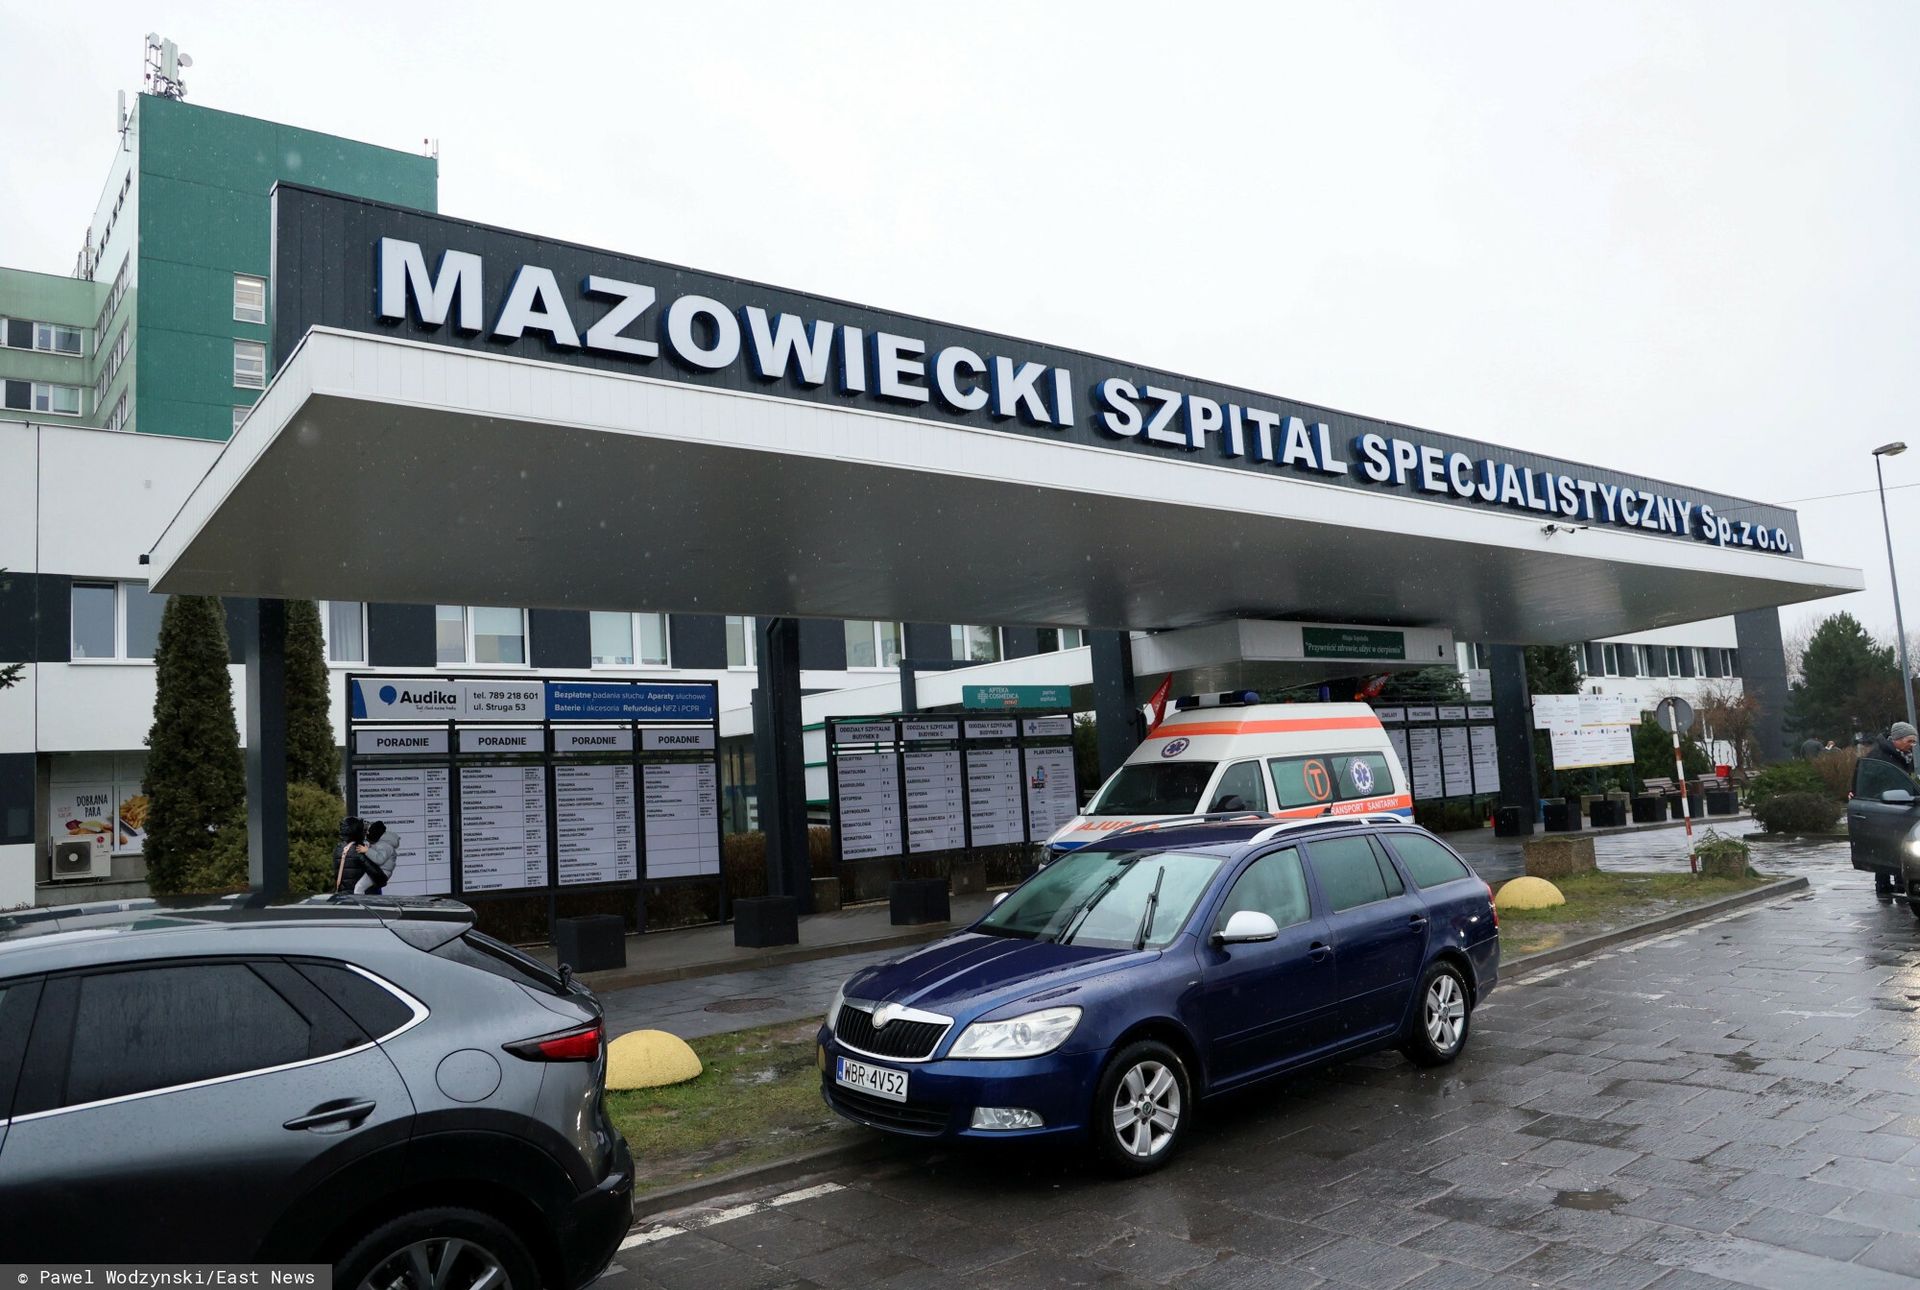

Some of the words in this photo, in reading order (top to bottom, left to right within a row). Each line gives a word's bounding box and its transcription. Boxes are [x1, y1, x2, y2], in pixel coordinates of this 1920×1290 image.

[378, 236, 1074, 427] MAZOWIECKI
[1099, 377, 1348, 474] SZPITAL
[1358, 433, 1692, 535] SPECJALISTYCZNY
[400, 690, 457, 704] Audika
[473, 692, 486, 700] tel.
[488, 692, 505, 700] 789
[506, 692, 522, 700] 218
[523, 692, 539, 700] 601
[554, 691, 592, 700] Bezpłatne
[593, 691, 621, 700] badania
[622, 692, 644, 700] słuchu
[647, 692, 675, 701] Aparaty
[473, 703, 484, 711] ul.
[485, 703, 513, 712] Struga
[515, 703, 526, 711] 53
[554, 704, 581, 712] Baterie
[623, 704, 662, 713] Refundacja
[376, 737, 430, 747] PORADNIE
[478, 737, 527, 746] PORADNIE
[571, 736, 617, 745] PORADNIE
[658, 735, 700, 744] PORADNIE
[1309, 768, 1322, 796] T
[76, 793, 108, 807] DOBRANA
[1331, 803, 1364, 815] RANSPORT
[1368, 798, 1399, 811] SANITARNY
[84, 806, 102, 818] PARA
[844, 1061, 866, 1086] WBR
[870, 1069, 904, 1095] 4V52
